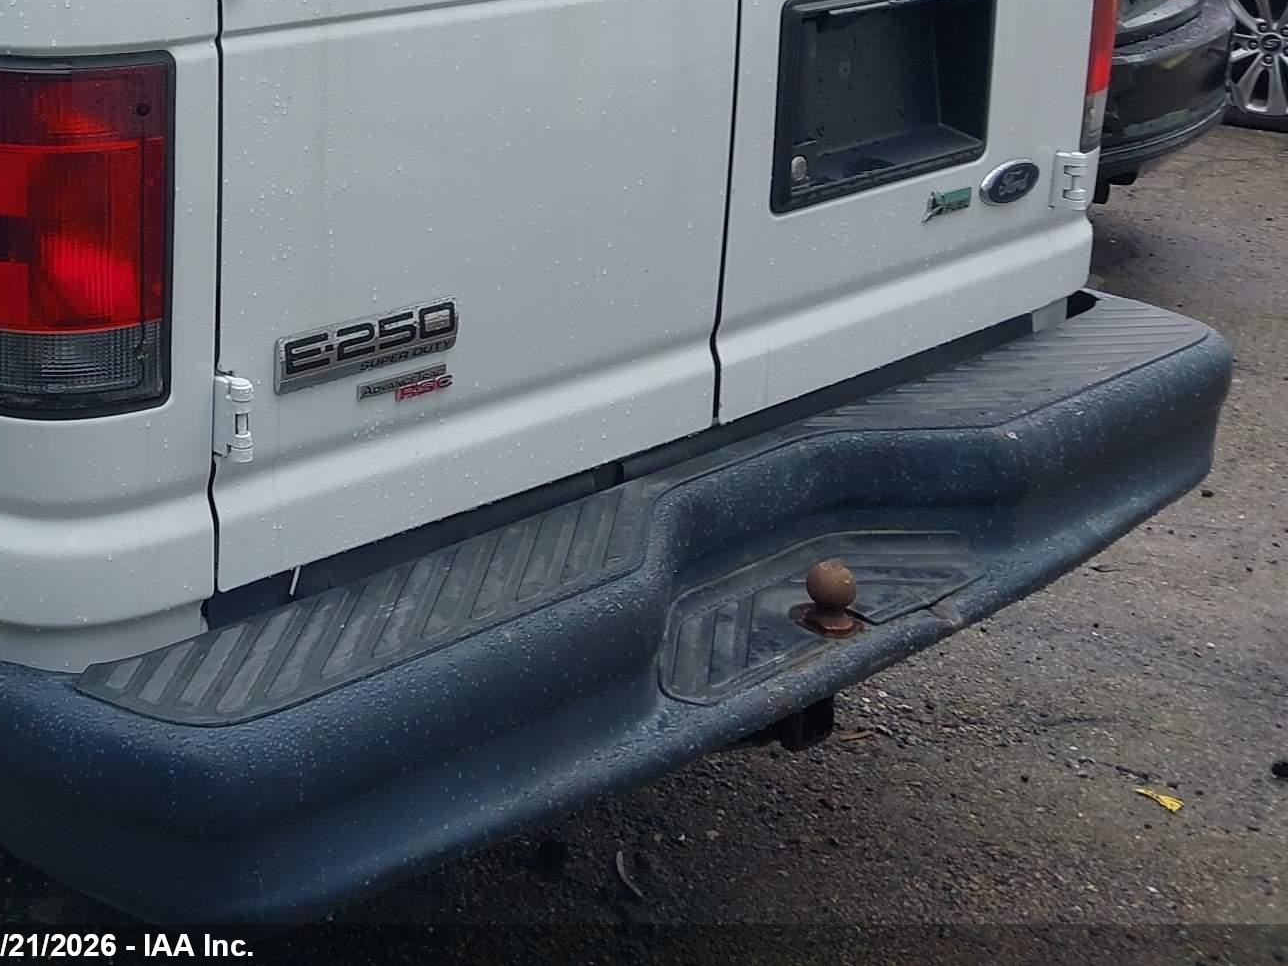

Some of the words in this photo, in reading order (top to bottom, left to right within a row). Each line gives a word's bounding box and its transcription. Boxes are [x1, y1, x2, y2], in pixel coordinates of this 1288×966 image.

[284, 300, 457, 375] E-250
[360, 350, 410, 371] SUPER
[412, 339, 451, 357] DUTY
[396, 374, 454, 402] RSC
